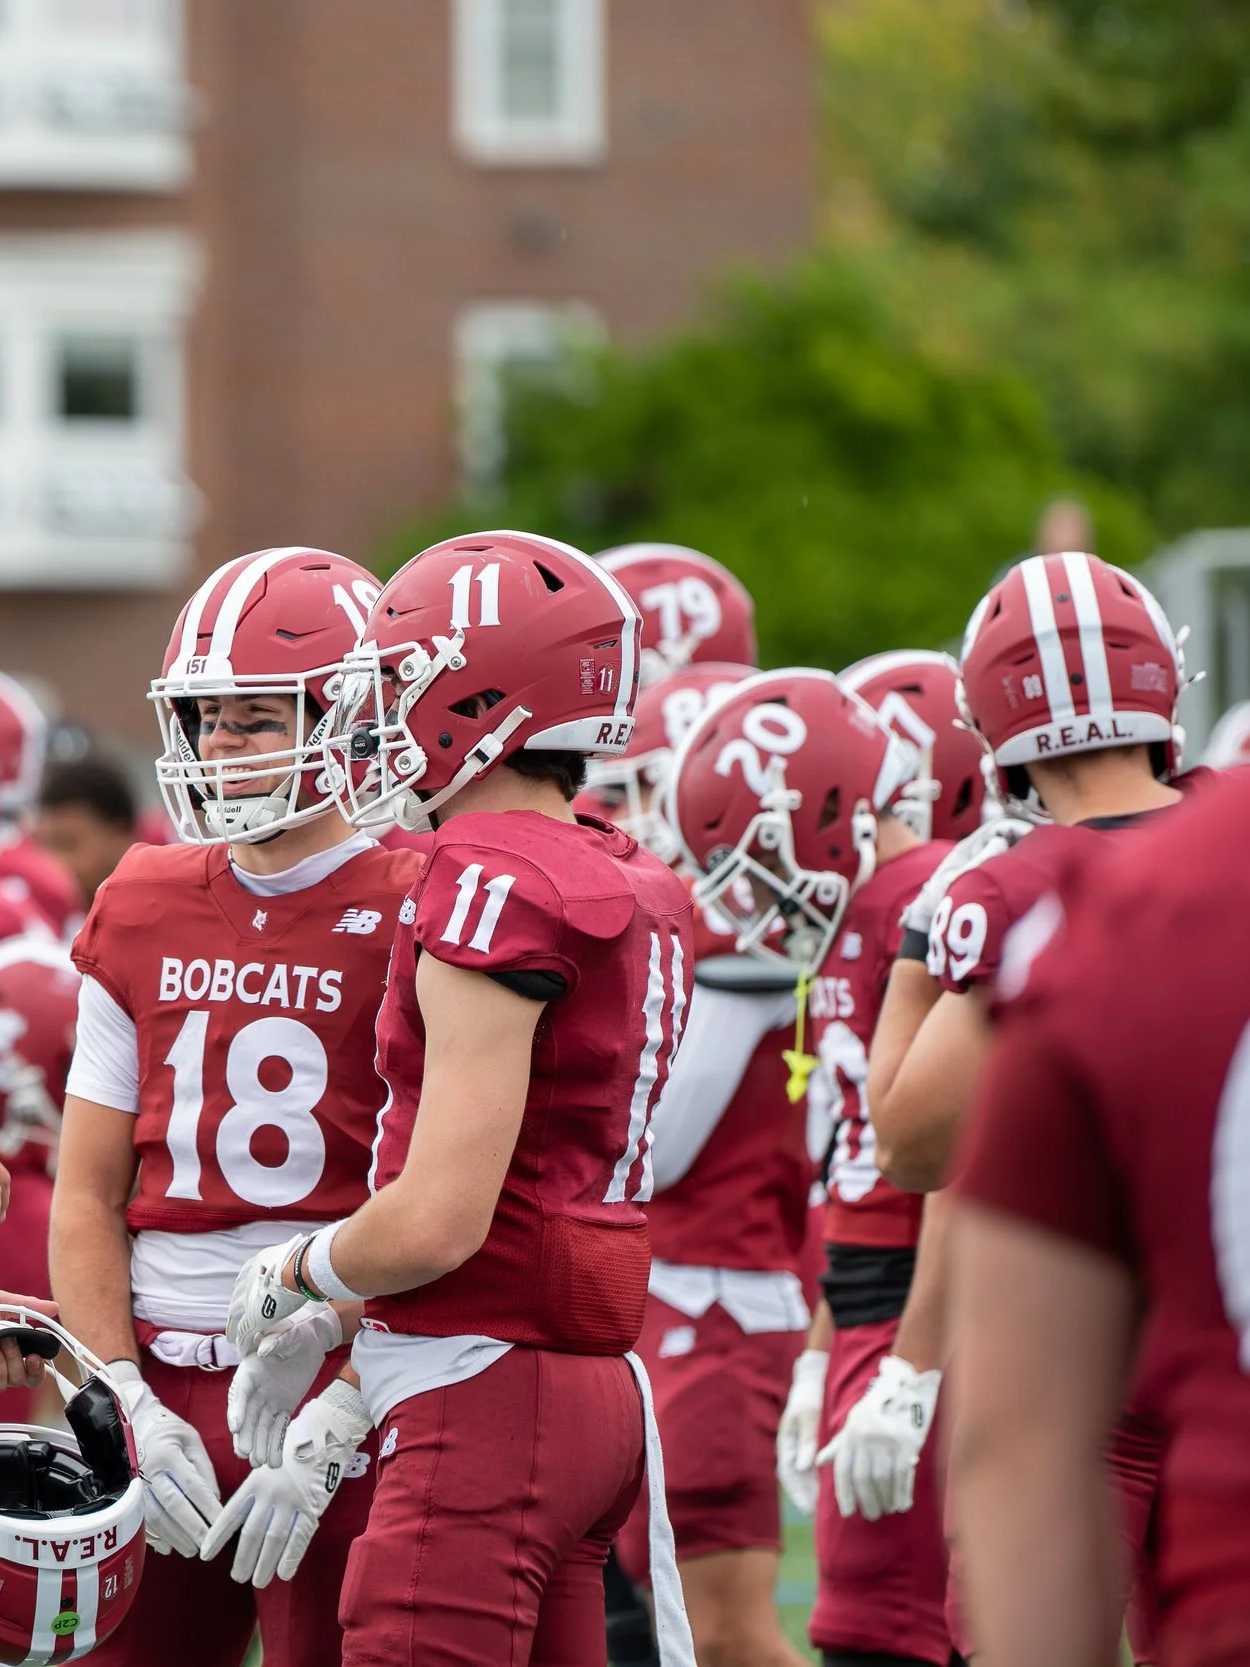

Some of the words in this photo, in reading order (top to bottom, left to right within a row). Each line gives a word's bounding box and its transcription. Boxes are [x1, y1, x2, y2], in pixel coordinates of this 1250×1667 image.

[447, 562, 502, 630] 11
[641, 577, 723, 643] 79
[185, 658, 208, 675] 151
[598, 667, 614, 692] 11
[714, 703, 808, 802] 20
[1035, 719, 1133, 754] R.E.A.L.
[439, 863, 517, 955] 11
[926, 896, 988, 981] 89
[158, 956, 343, 1013] BOBCATS
[602, 931, 686, 1203] 11
[163, 1010, 328, 1208] 18
[14, 1524, 118, 1562] R.E.A.L.
[104, 1573, 118, 1599] 12
[53, 1616, 79, 1630] C2P
